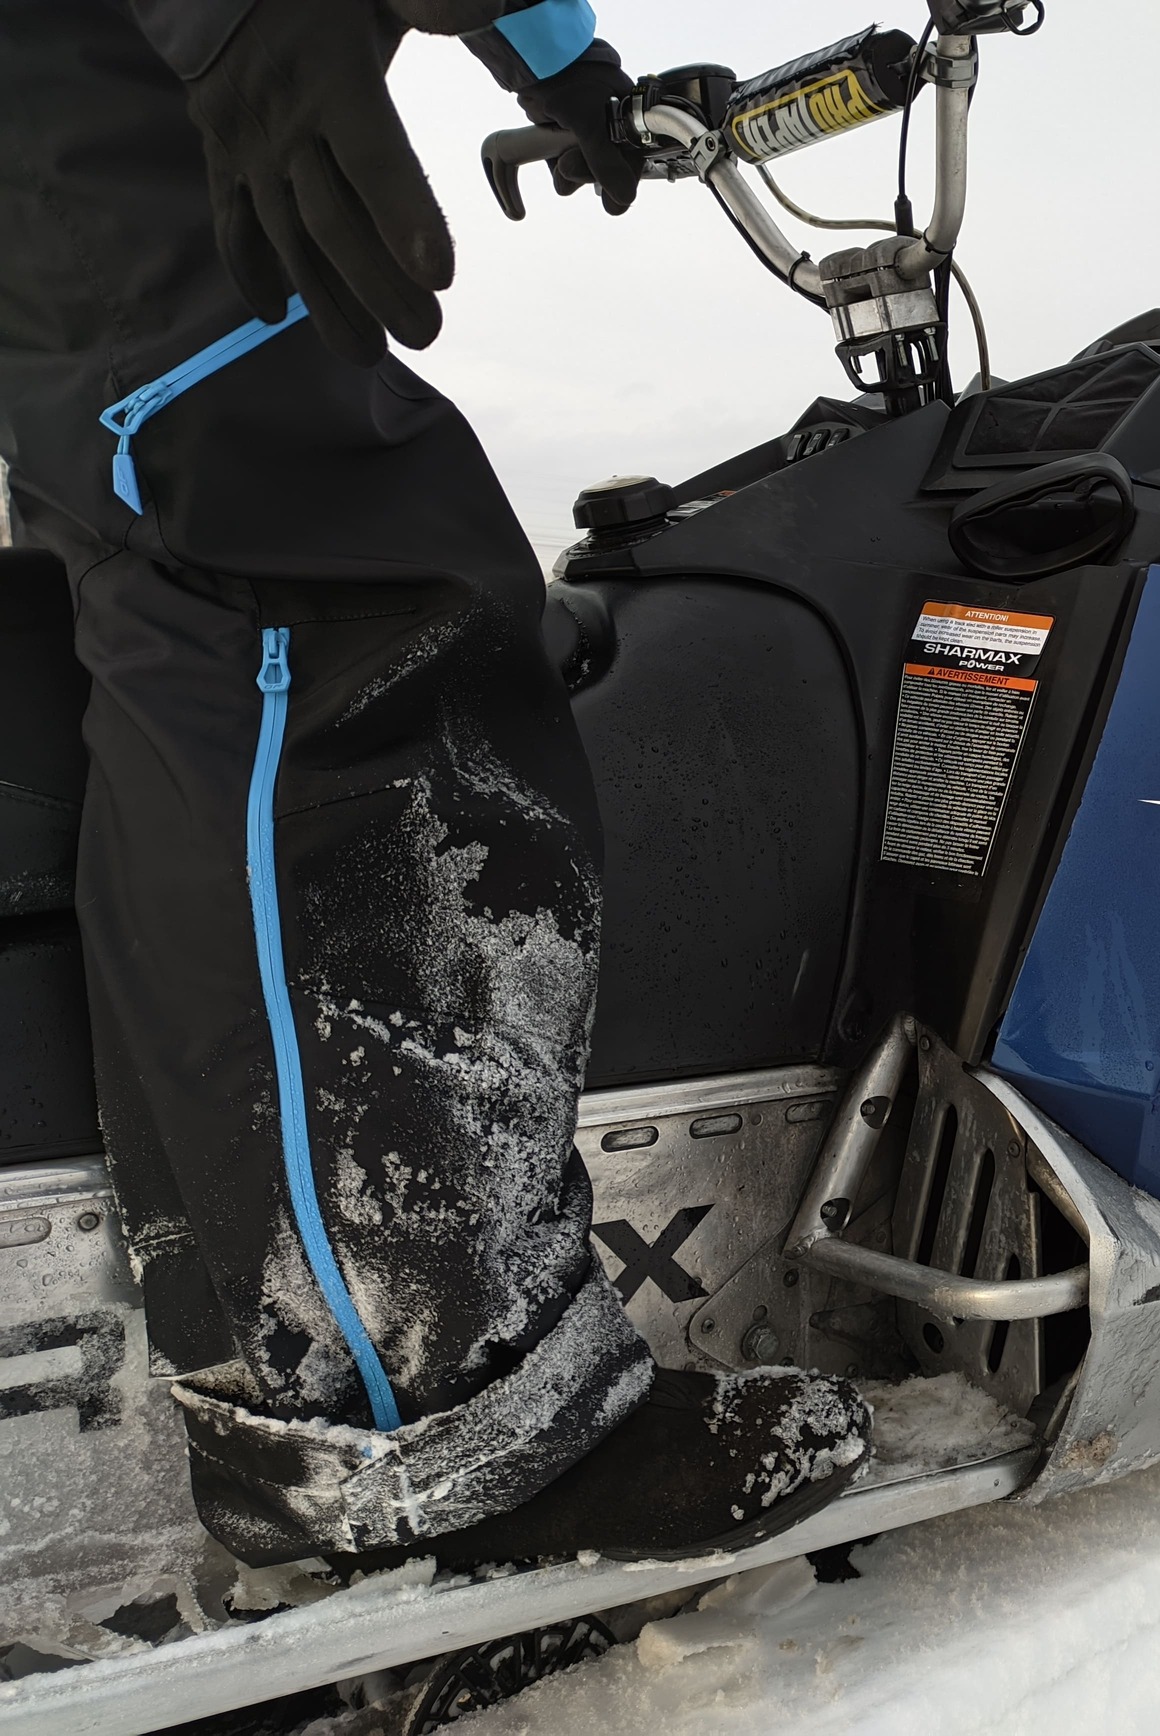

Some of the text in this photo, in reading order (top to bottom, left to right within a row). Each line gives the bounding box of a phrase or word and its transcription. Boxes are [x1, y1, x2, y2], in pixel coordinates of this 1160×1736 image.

[965, 610, 1009, 622] ATTENTION!
[923, 643, 1022, 664] SHARMAX
[959, 659, 1004, 672] POWER
[936, 667, 1010, 686] AVERTISSEMENT
